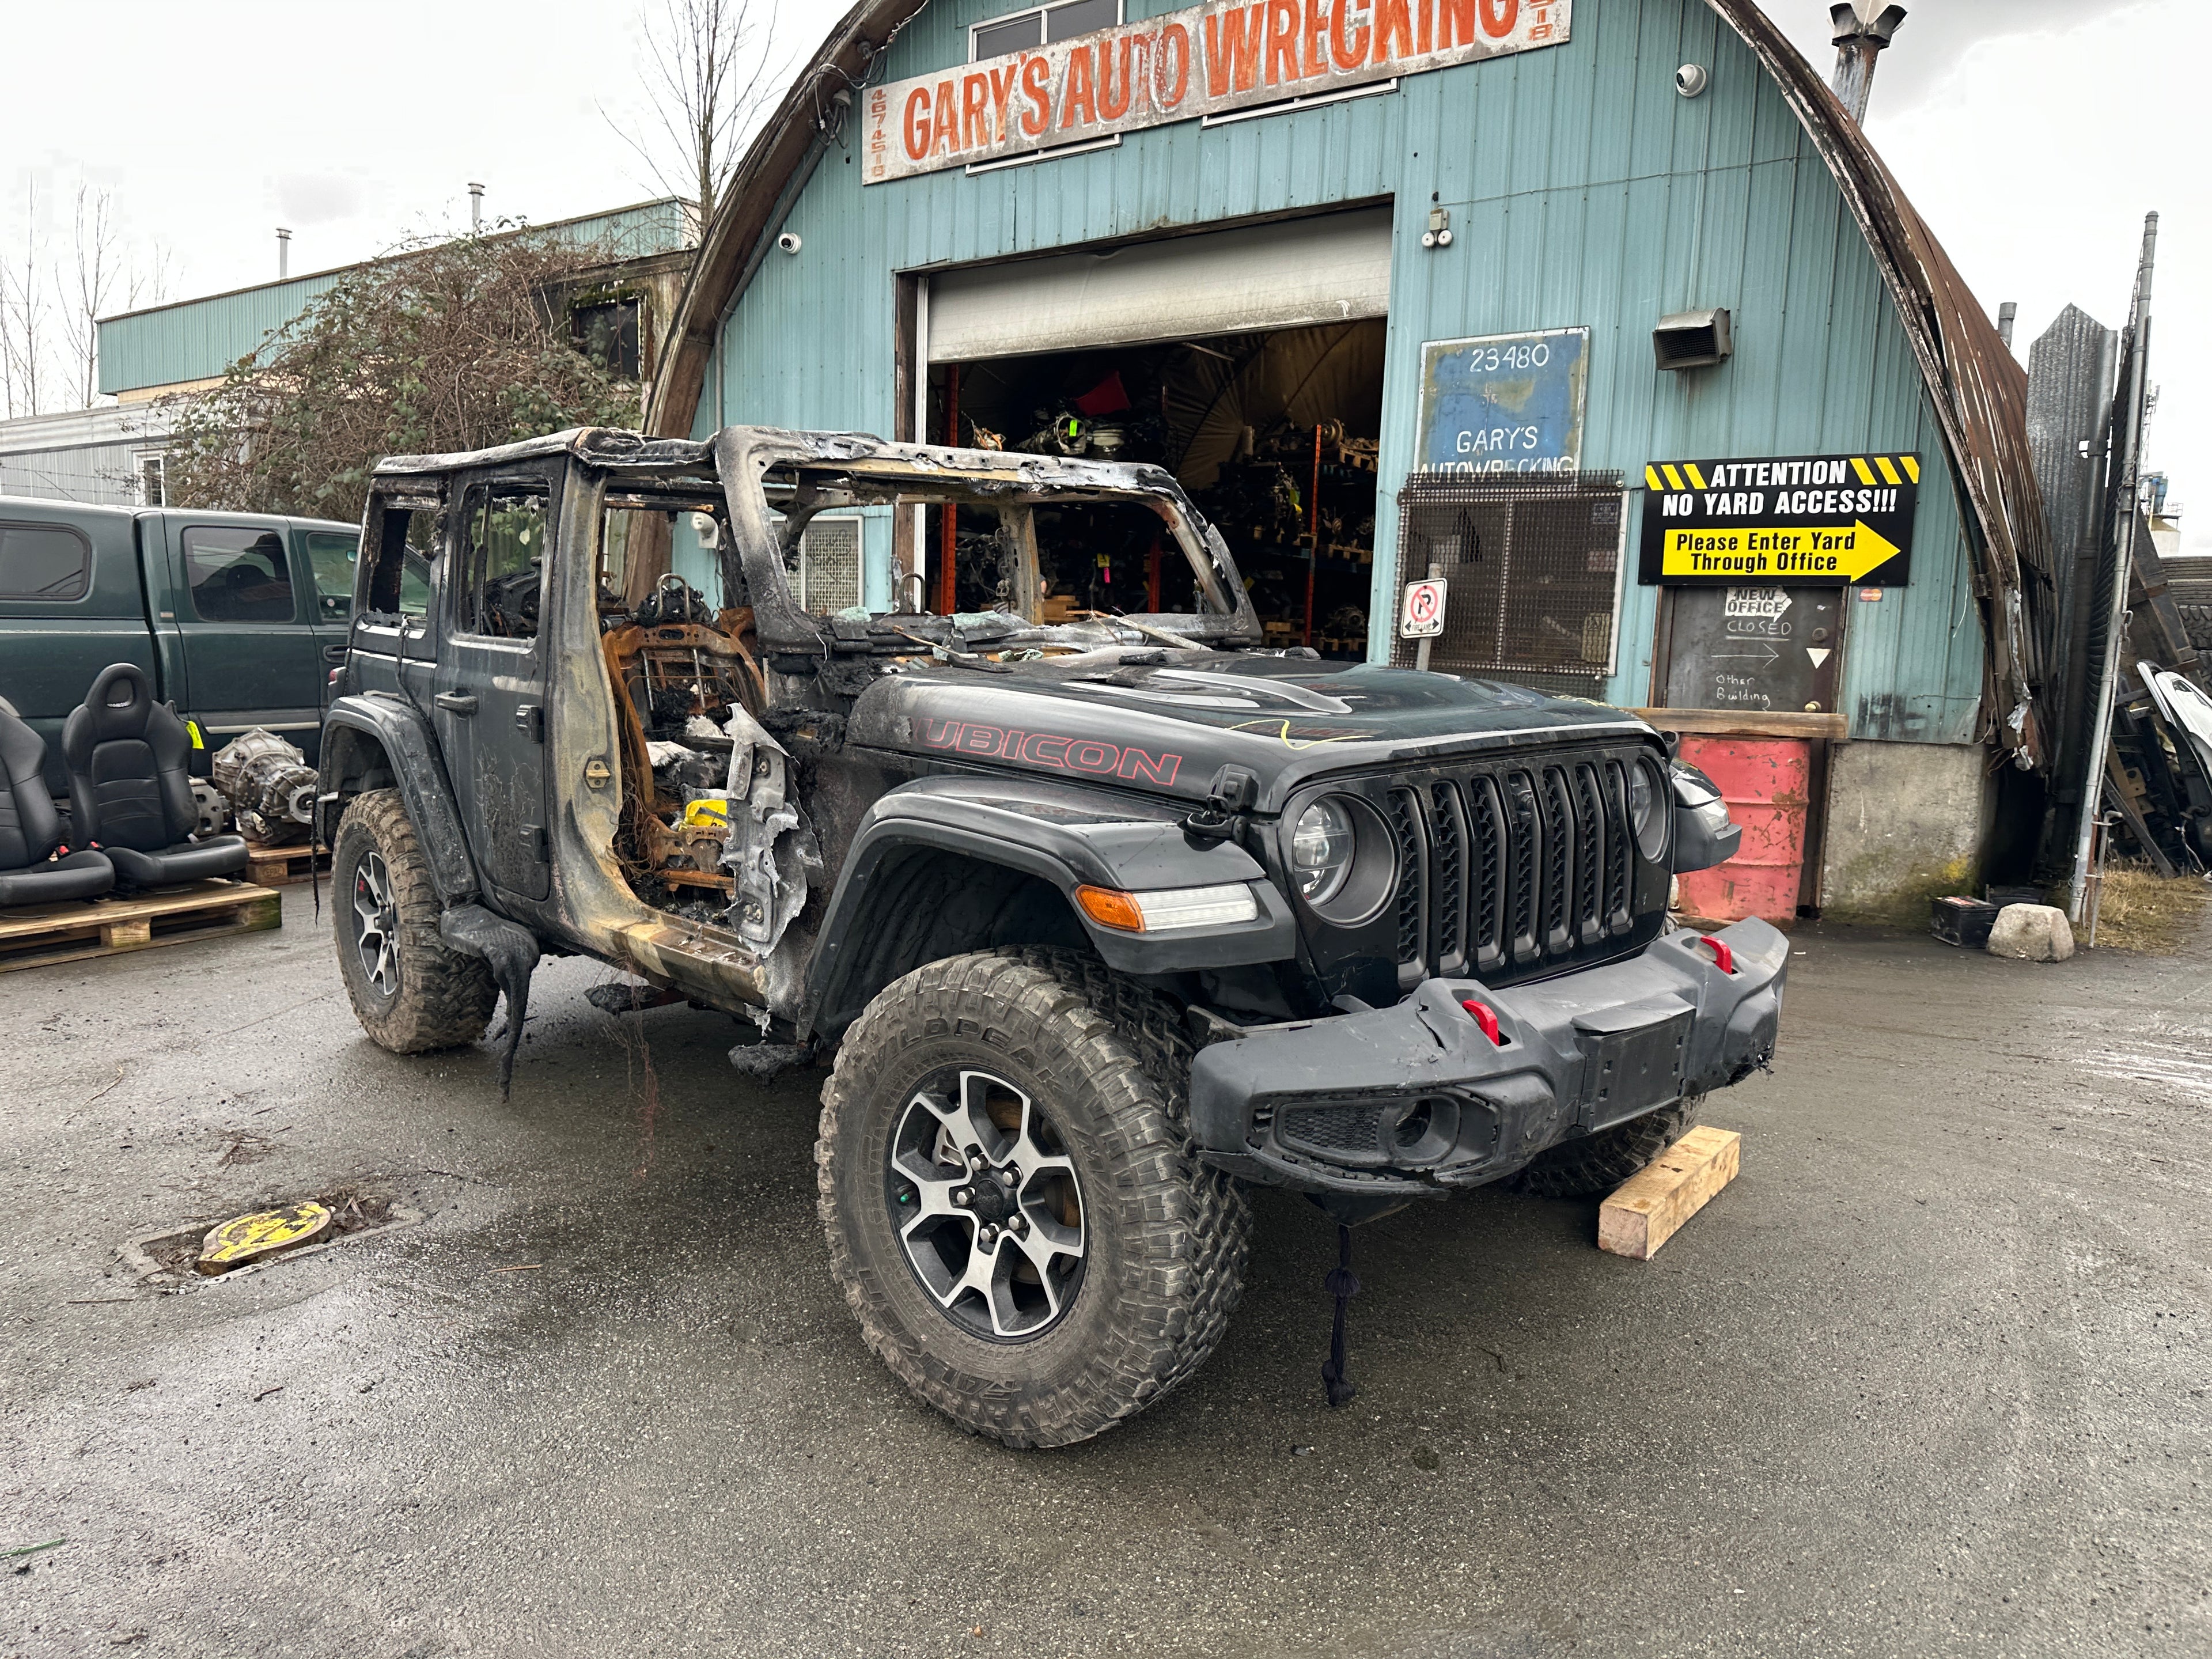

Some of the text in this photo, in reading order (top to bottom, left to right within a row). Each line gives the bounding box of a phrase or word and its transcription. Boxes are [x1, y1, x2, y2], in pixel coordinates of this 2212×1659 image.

[903, 0, 1520, 161] GARY'S AUTO WRECKING
[1469, 343, 1550, 373] 23480
[1456, 426, 1538, 453] GARY'S
[1710, 460, 1847, 487] ATTENTION
[1662, 488, 1897, 516] NO YARD ACCESS!!!
[1676, 531, 1856, 551] Please Enter Yard
[1691, 552, 1838, 574] Through Office
[1737, 588, 1774, 600] NEW
[1728, 601, 1784, 613] OFFICE
[1727, 620, 1791, 635] CLOSED
[1717, 687, 1771, 709] Building
[912, 717, 1183, 787] UBICON
